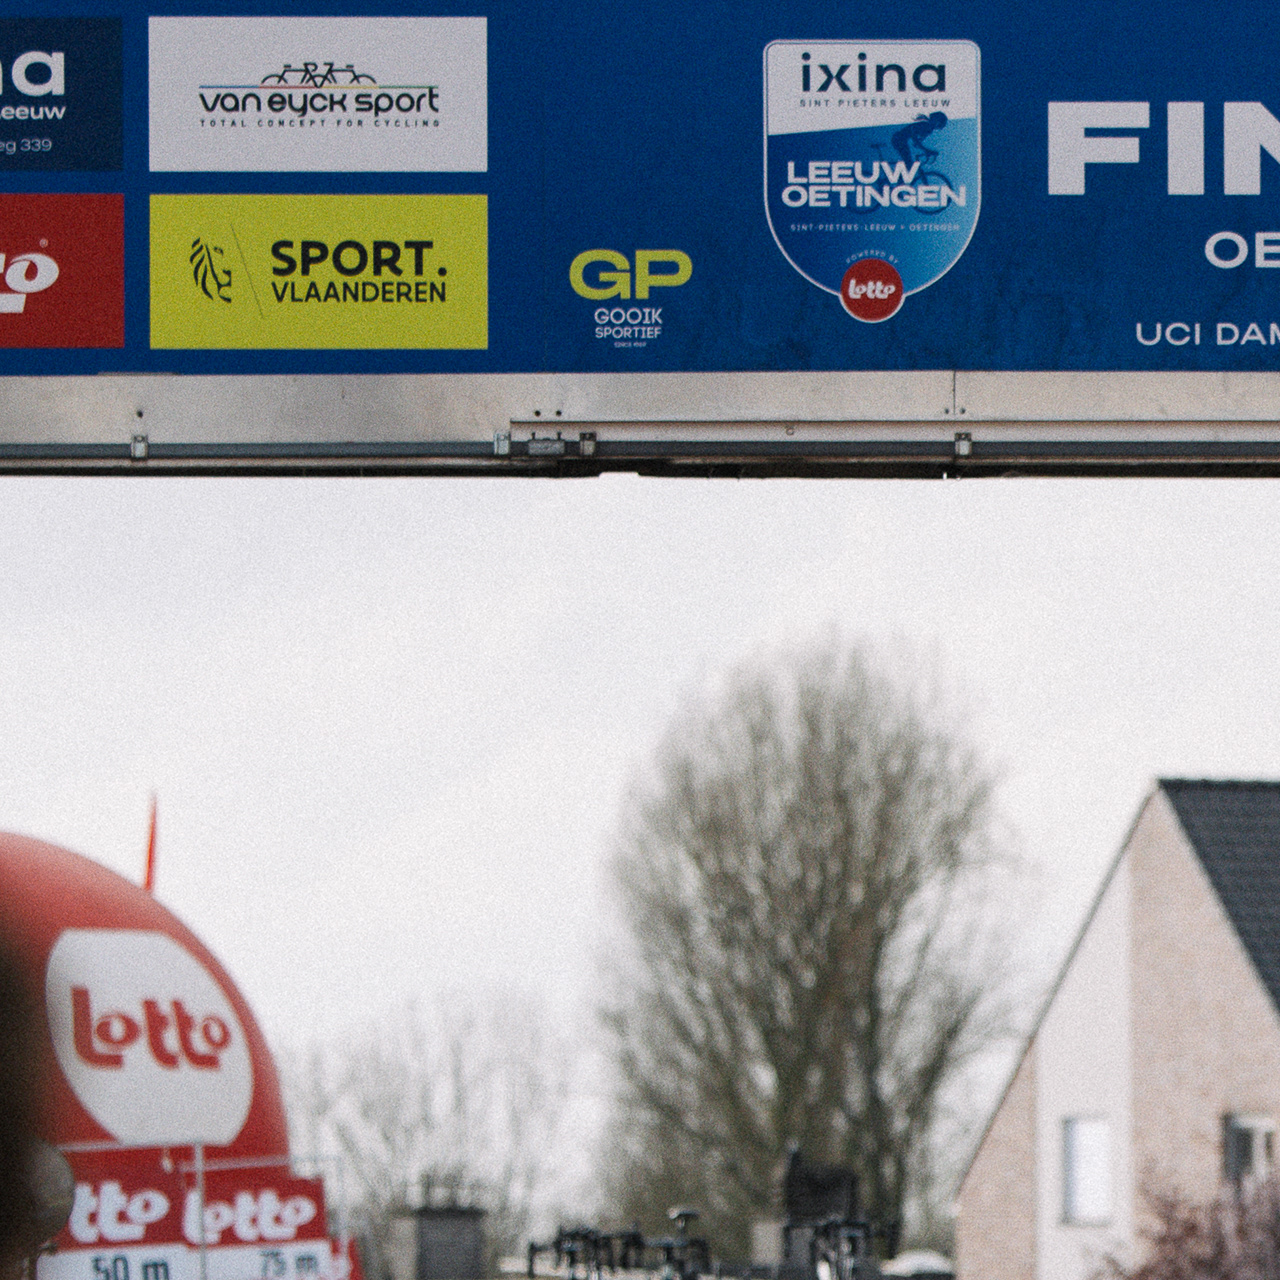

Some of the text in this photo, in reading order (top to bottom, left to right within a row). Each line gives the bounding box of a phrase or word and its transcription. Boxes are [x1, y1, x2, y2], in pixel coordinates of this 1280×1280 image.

[802, 52, 946, 93] ixina
[200, 87, 439, 117] van eyck sport
[799, 99, 951, 108] SINT PIETERS LEEUW
[200, 119, 439, 128] TOTAL CONCEPT FOR CYCLING
[20, 139, 52, 152] 339
[787, 161, 920, 184] LEEUW
[781, 185, 966, 208] OETINGEN
[271, 240, 447, 277] SPORT.
[569, 248, 693, 300] GP
[271, 281, 446, 303] VLAANDEREN
[848, 279, 896, 299] lotto
[594, 307, 663, 325] GOOIK
[595, 326, 662, 339] SPORTIEF
[1136, 322, 1200, 346] UCI
[71, 986, 231, 1070] lotto
[182, 1187, 318, 1244] lotto
